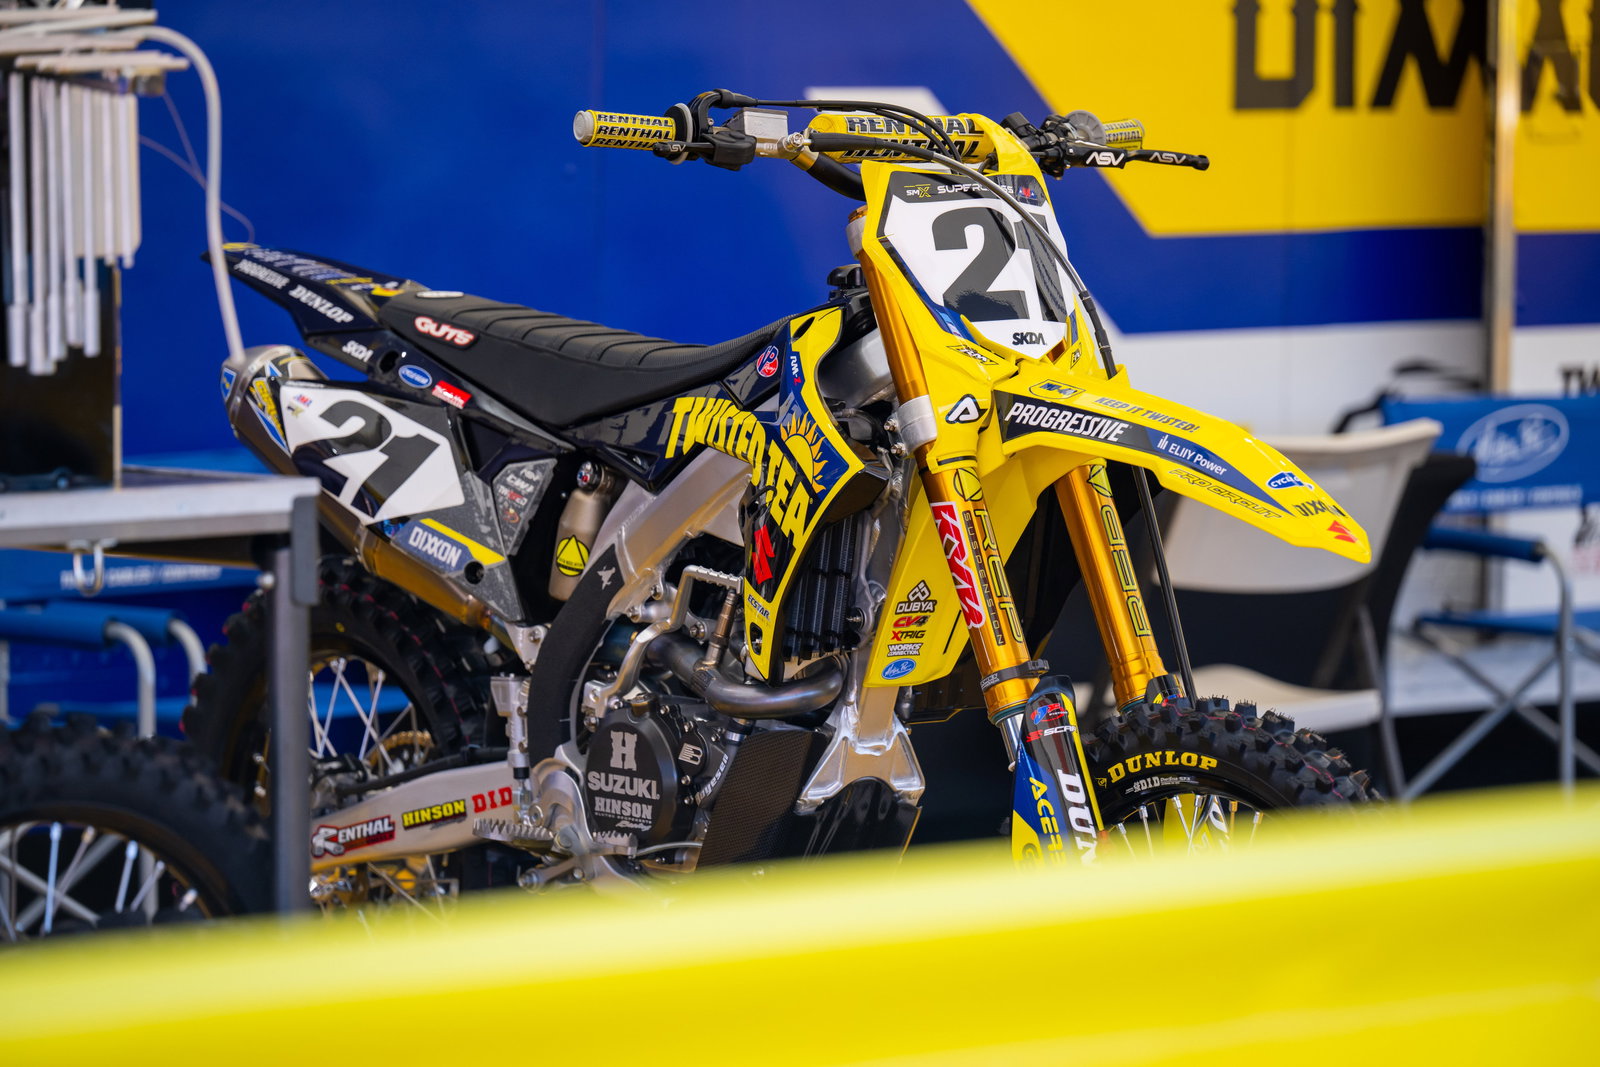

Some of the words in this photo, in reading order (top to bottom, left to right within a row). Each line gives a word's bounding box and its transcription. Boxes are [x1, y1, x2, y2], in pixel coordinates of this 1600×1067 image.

[596, 125, 673, 141] RENTHAL
[597, 113, 673, 128] RENTHAL
[1086, 151, 1125, 167] ASV
[1149, 151, 1187, 165] ASV
[931, 206, 1068, 324] 21
[288, 284, 355, 323] DUNLOP
[414, 316, 475, 345] GUTS
[1004, 402, 1130, 443] PROGRESSIVE
[1095, 397, 1130, 410] KEEP
[1126, 403, 1144, 414] IT
[1140, 409, 1200, 433] TWISTED!
[664, 396, 766, 487] TWISTED
[292, 400, 441, 520] 21
[1193, 453, 1228, 476] Power
[765, 439, 812, 552] TEA
[1168, 468, 1212, 487] PRO
[1207, 482, 1283, 519] CIRCUIT
[408, 526, 462, 568] DIXXON
[963, 511, 1007, 646] SUSPENSION
[973, 508, 1024, 644] REP
[1100, 504, 1153, 638] REP
[747, 593, 771, 622] ECSTAR
[893, 614, 931, 628] CV4
[896, 601, 935, 614] DUBYA
[888, 643, 922, 653] WORKS
[890, 630, 927, 642] XTRIG
[1107, 750, 1218, 784] DUNLOP
[588, 771, 656, 800] SUZUKI
[401, 800, 466, 828] HINSON
[471, 792, 514, 814] DID
[594, 796, 653, 820] HINSON
